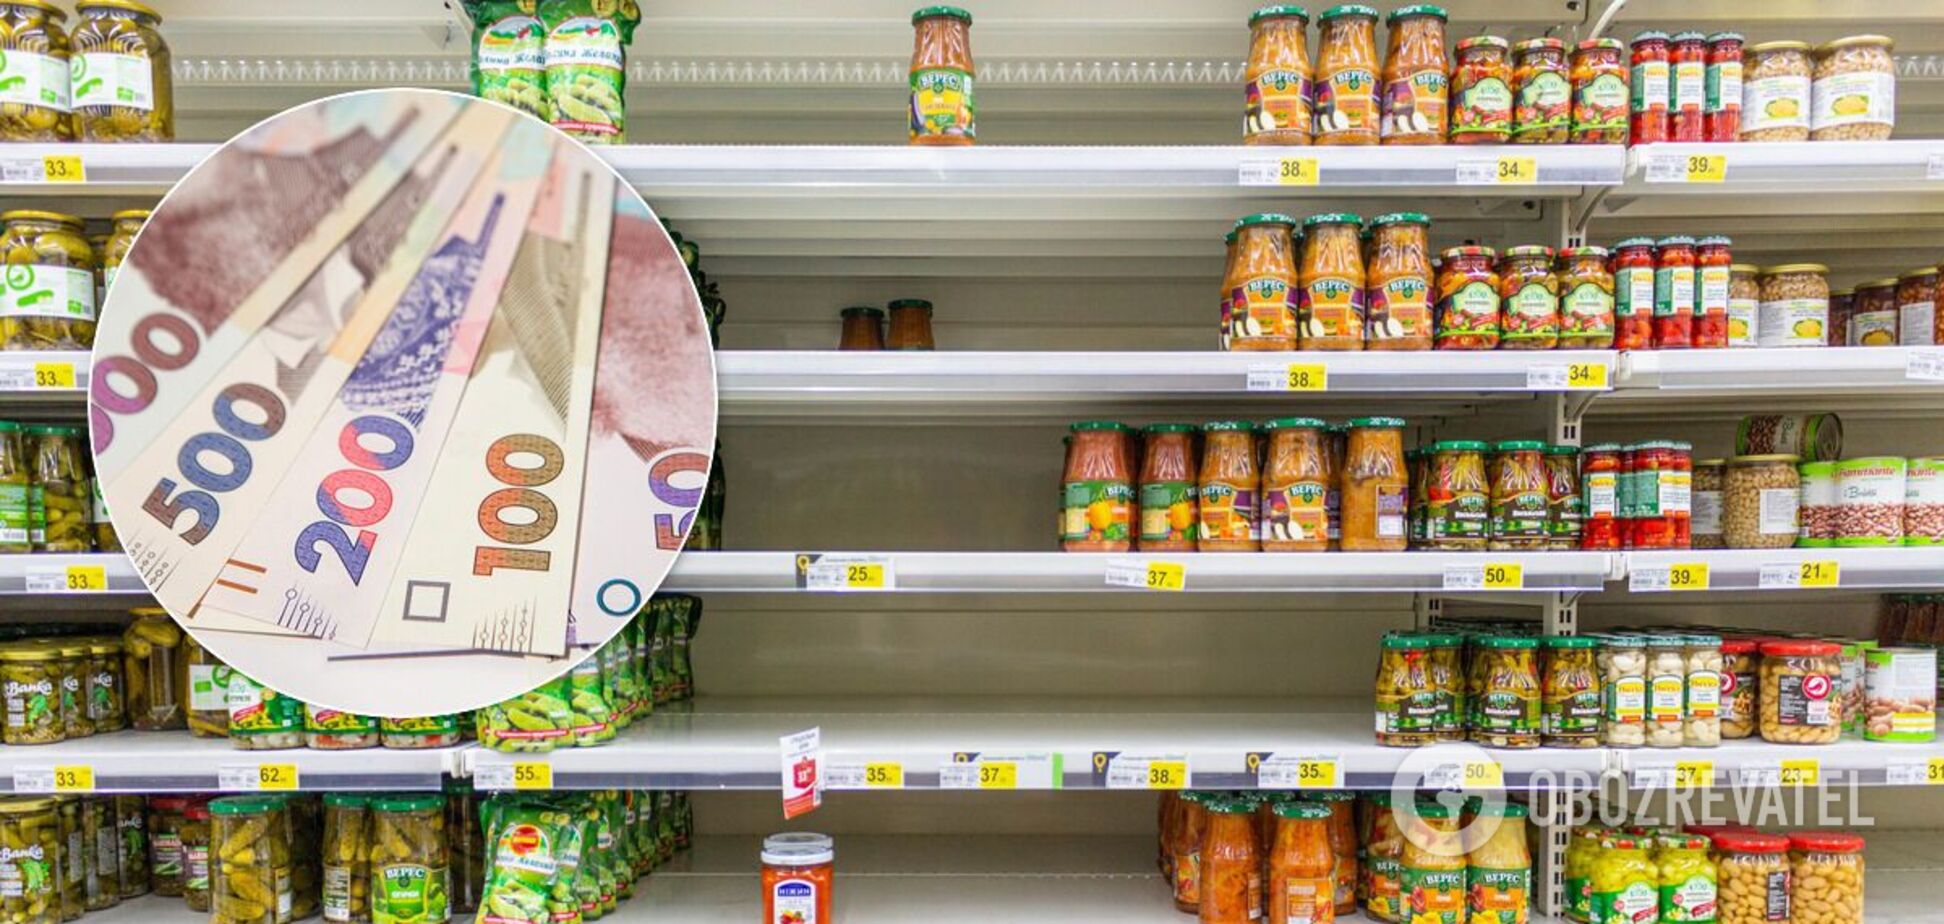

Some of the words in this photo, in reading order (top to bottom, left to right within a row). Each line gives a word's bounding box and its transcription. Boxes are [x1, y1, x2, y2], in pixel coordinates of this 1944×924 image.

[1262, 70, 1298, 85] ВЕРЕС
[1335, 70, 1371, 85] ВЕРЕС
[45, 160, 66, 176] 33
[1281, 161, 1300, 177] 38
[1499, 161, 1518, 177] 34
[1688, 156, 1708, 173] 39
[1249, 278, 1285, 292] ВЕРЕС
[1313, 278, 1350, 292] ВЕРЕС
[1389, 278, 1425, 292] ВЕРЕС
[36, 371, 56, 386] 33
[1289, 372, 1309, 388] 38
[1570, 365, 1589, 380] 34
[142, 382, 286, 546] 500
[1290, 484, 1323, 497] ВЕРЕС
[294, 415, 415, 586] 200
[473, 433, 564, 577] 100
[849, 566, 868, 581] 25
[1147, 570, 1167, 586] 37
[1486, 568, 1505, 583] 50
[1671, 569, 1690, 584] 39
[1802, 563, 1821, 579] 21
[69, 574, 88, 589] 33
[260, 768, 279, 783] 62
[515, 766, 534, 781] 55
[867, 768, 886, 782] 35
[981, 767, 1000, 782] 37
[1151, 769, 1170, 784] 38
[1300, 763, 1319, 778] 35
[1465, 764, 1485, 779] 50
[56, 772, 76, 787] 33
[385, 865, 426, 879] ВЕРЕС
[1426, 872, 1459, 884] ВЕРЕС
[1484, 872, 1521, 884] ВЕРЕС
